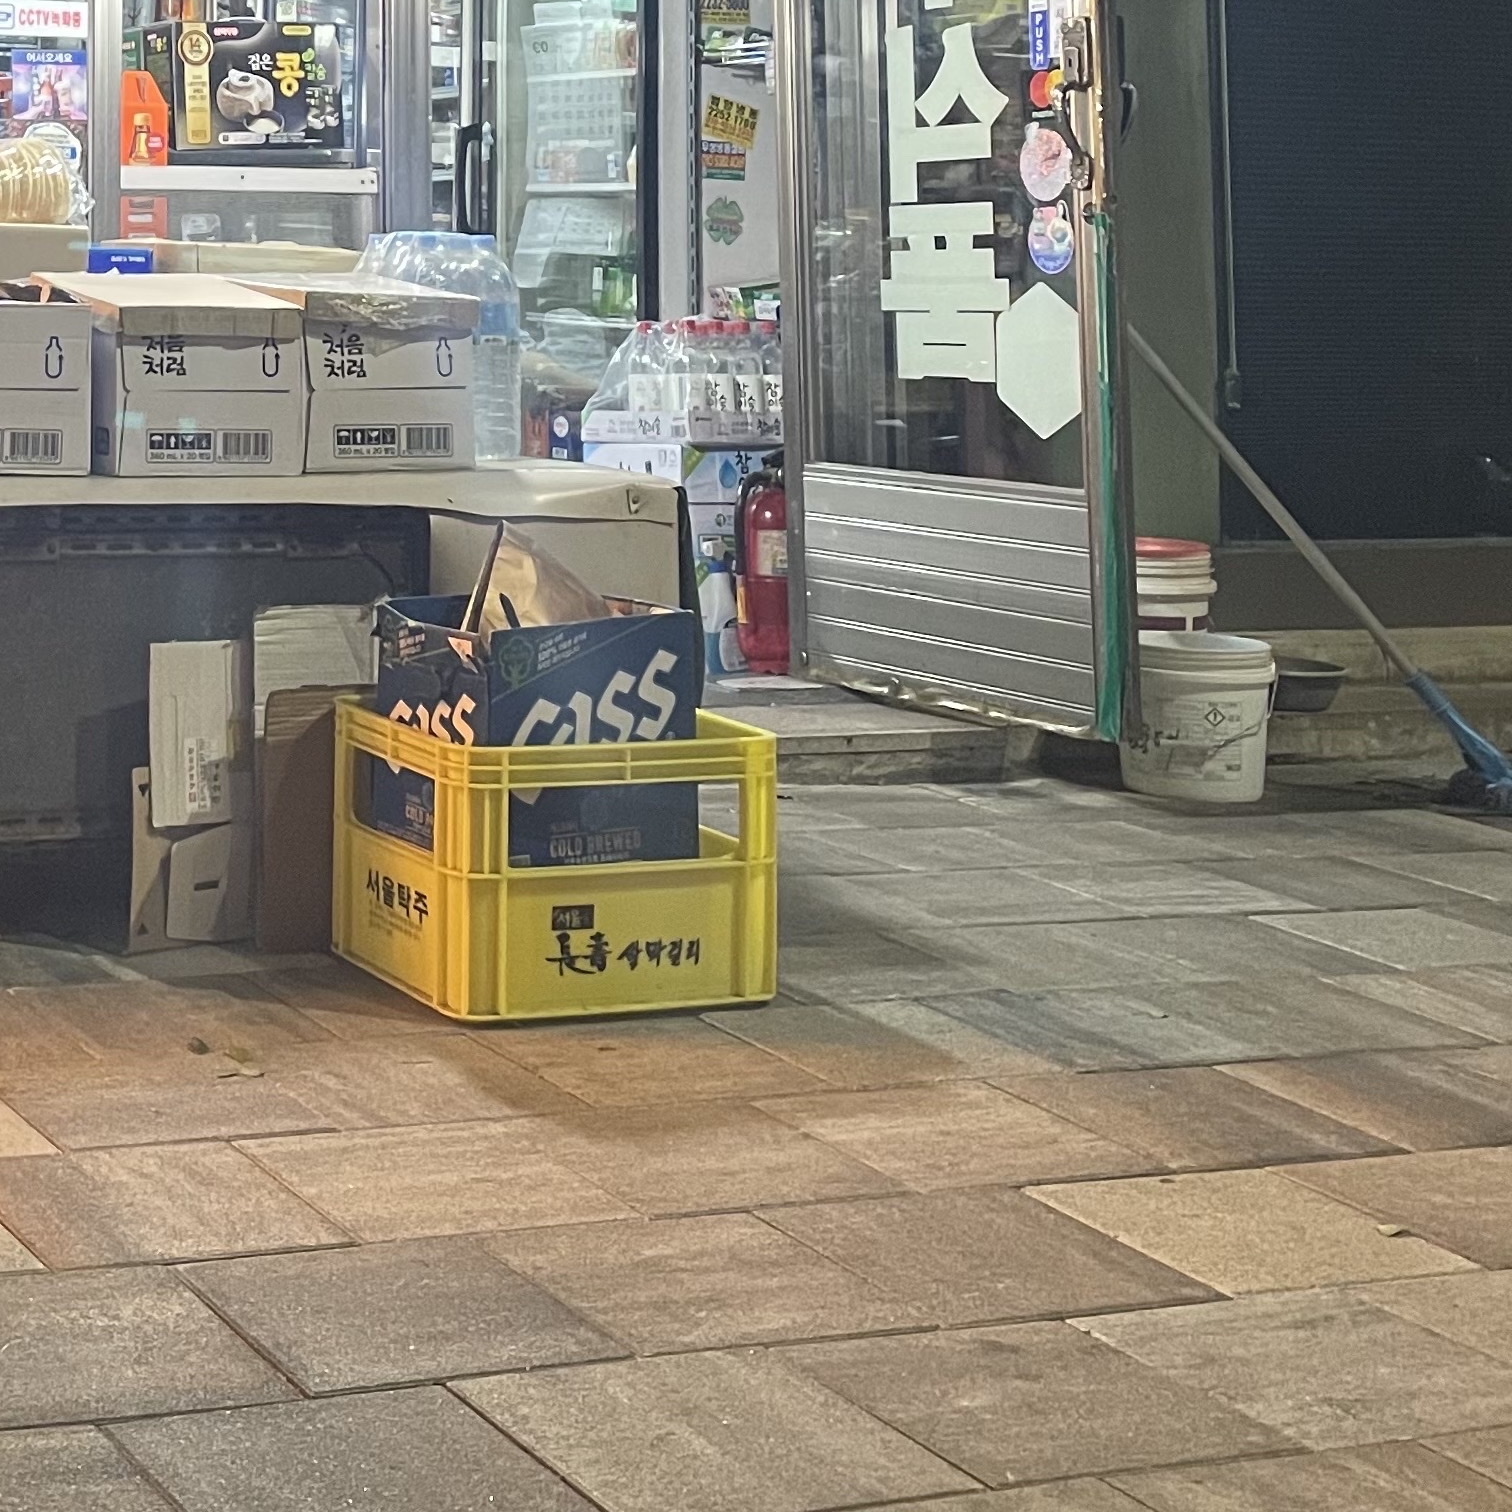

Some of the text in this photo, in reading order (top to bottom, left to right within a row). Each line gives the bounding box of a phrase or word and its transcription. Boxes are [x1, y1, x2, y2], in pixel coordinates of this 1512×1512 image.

[1034, 13, 1044, 65] PUSH
[322, 332, 365, 356] 처음
[142, 355, 187, 376] 처럼
[323, 357, 367, 379] 처럼
[366, 868, 429, 925] 서울탁주
